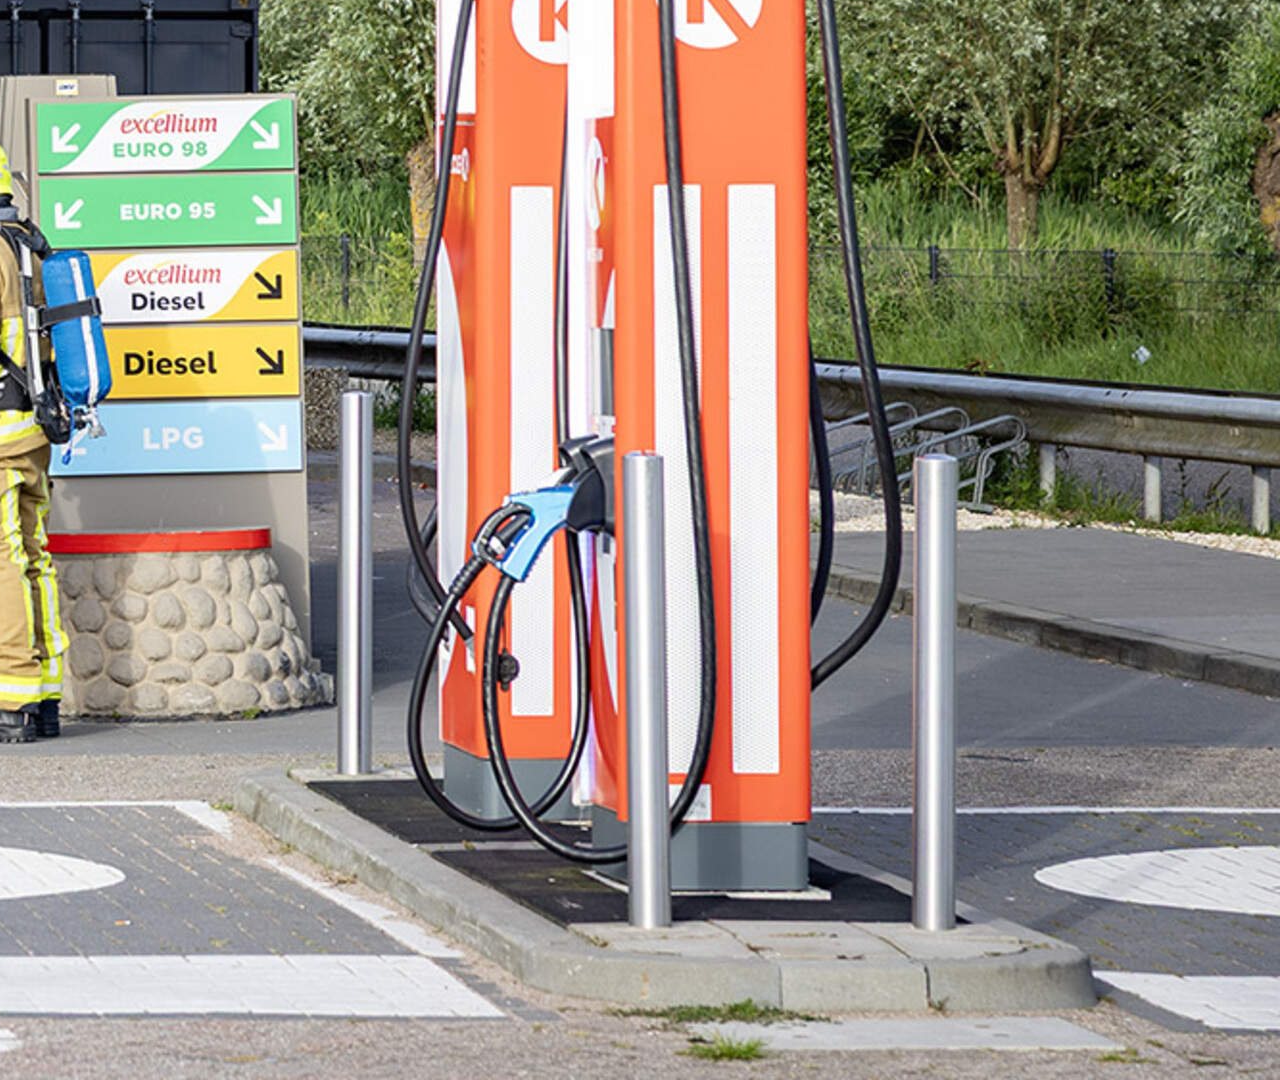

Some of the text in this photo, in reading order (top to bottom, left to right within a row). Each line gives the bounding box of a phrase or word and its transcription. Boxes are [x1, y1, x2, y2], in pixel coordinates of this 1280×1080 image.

[120, 113, 218, 135] excellium
[113, 141, 208, 159] EURO 98
[120, 202, 216, 221] EURO 95
[124, 263, 221, 286] excellium
[131, 291, 206, 312] Diesel
[123, 350, 218, 376] Diesel
[143, 427, 204, 450] LPG
